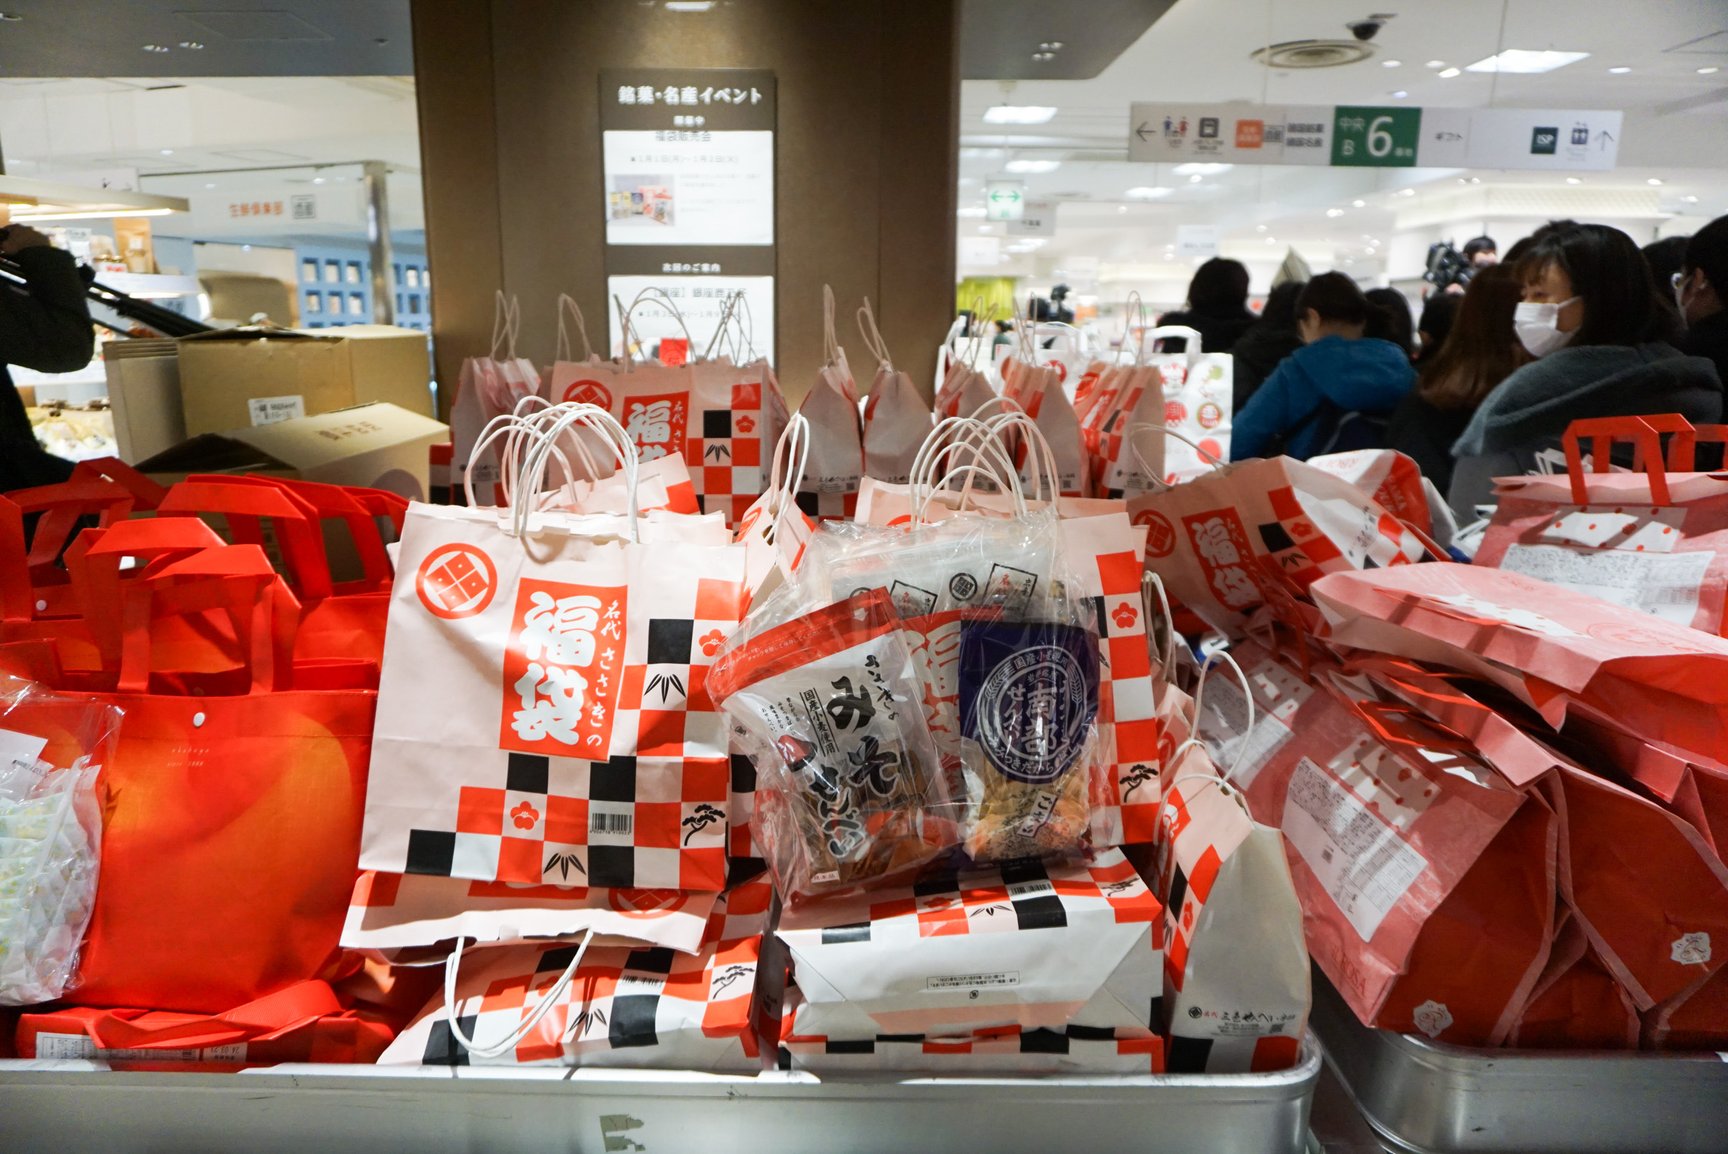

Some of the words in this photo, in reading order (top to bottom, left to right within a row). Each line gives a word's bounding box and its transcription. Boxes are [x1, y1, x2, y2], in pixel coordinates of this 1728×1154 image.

[618, 85, 762, 105] 銘菓・名産イベント
[1341, 139, 1354, 155] B
[1366, 115, 1394, 158] 6
[1190, 516, 1264, 606] 福袋
[601, 600, 622, 641] 名代
[510, 590, 602, 747] 福袋
[586, 647, 619, 748] ささきの
[802, 690, 837, 754] 国産小麦使用
[1020, 682, 1059, 756] 南部
